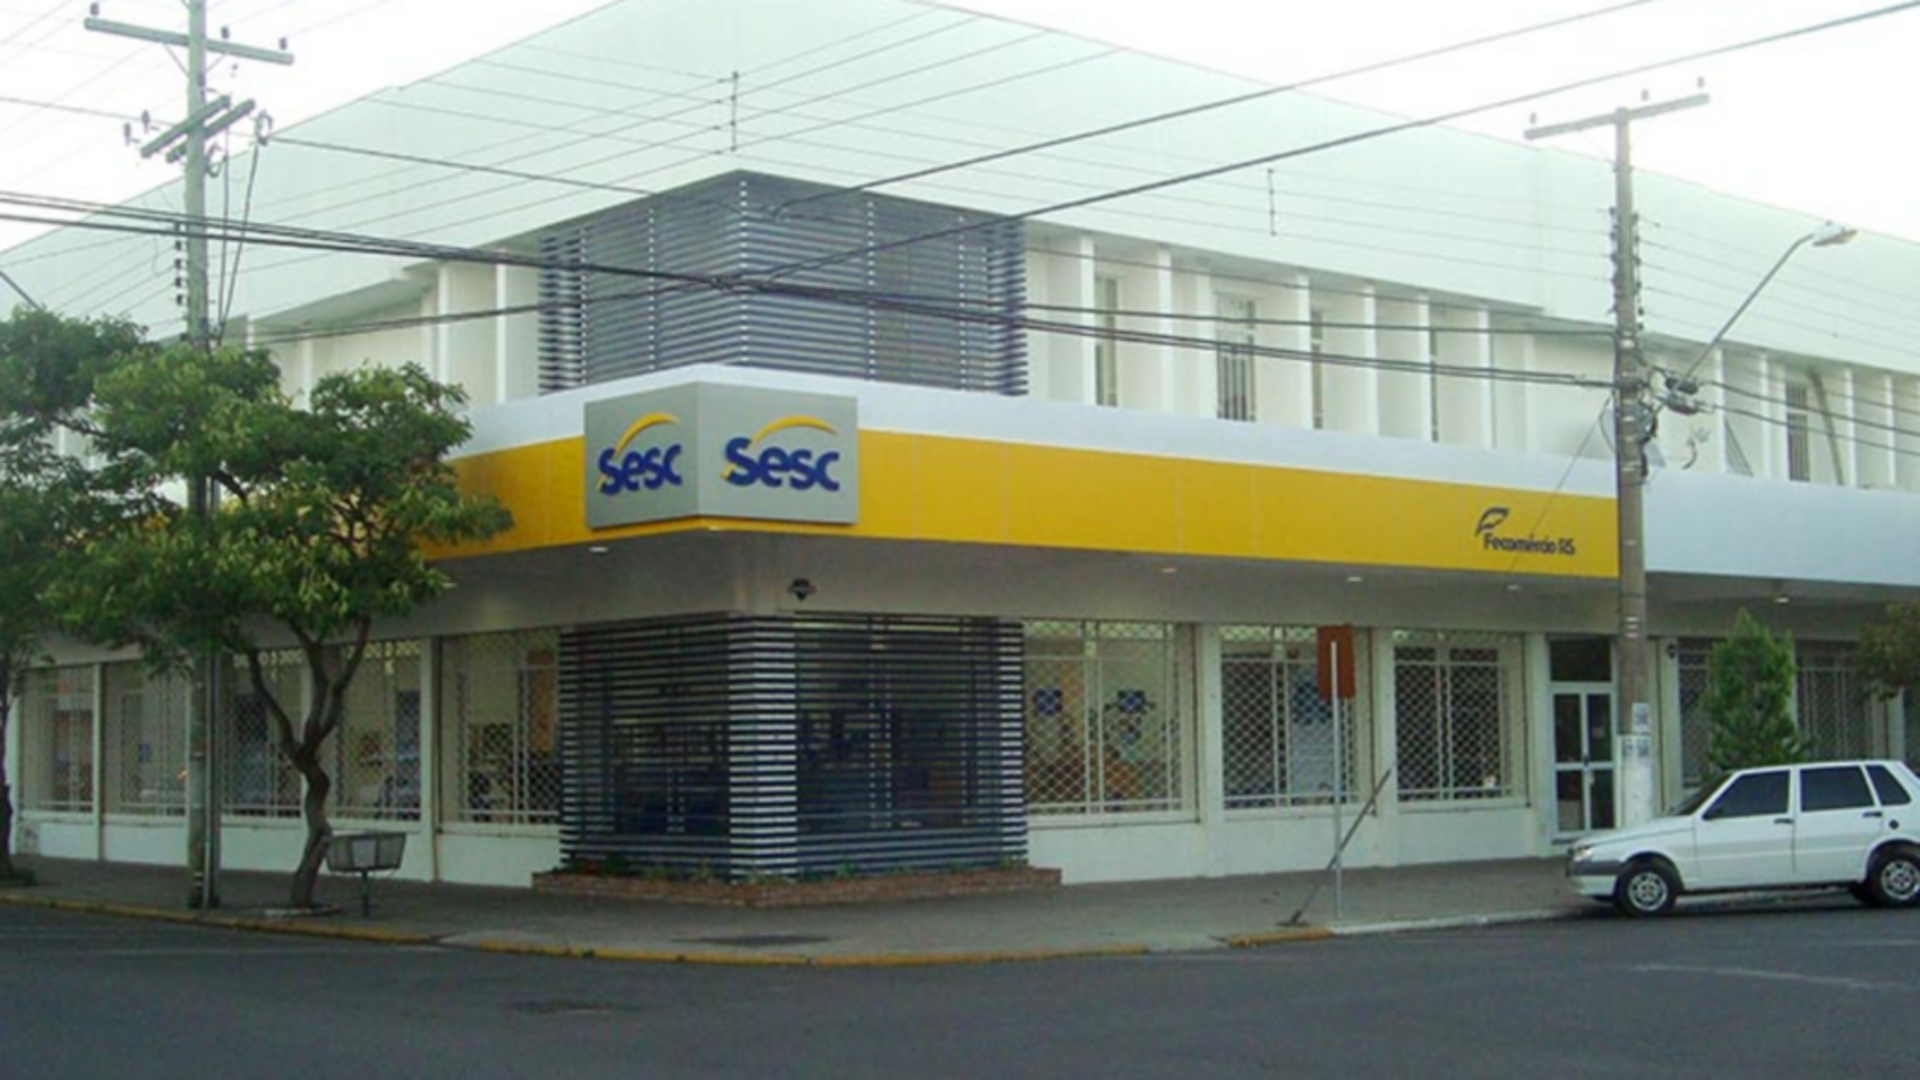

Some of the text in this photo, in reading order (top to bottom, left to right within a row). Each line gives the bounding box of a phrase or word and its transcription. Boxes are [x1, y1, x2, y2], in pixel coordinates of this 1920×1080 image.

[598, 443, 682, 495] Sesc
[724, 437, 840, 492] Sesc
[1558, 537, 1576, 556] RS
